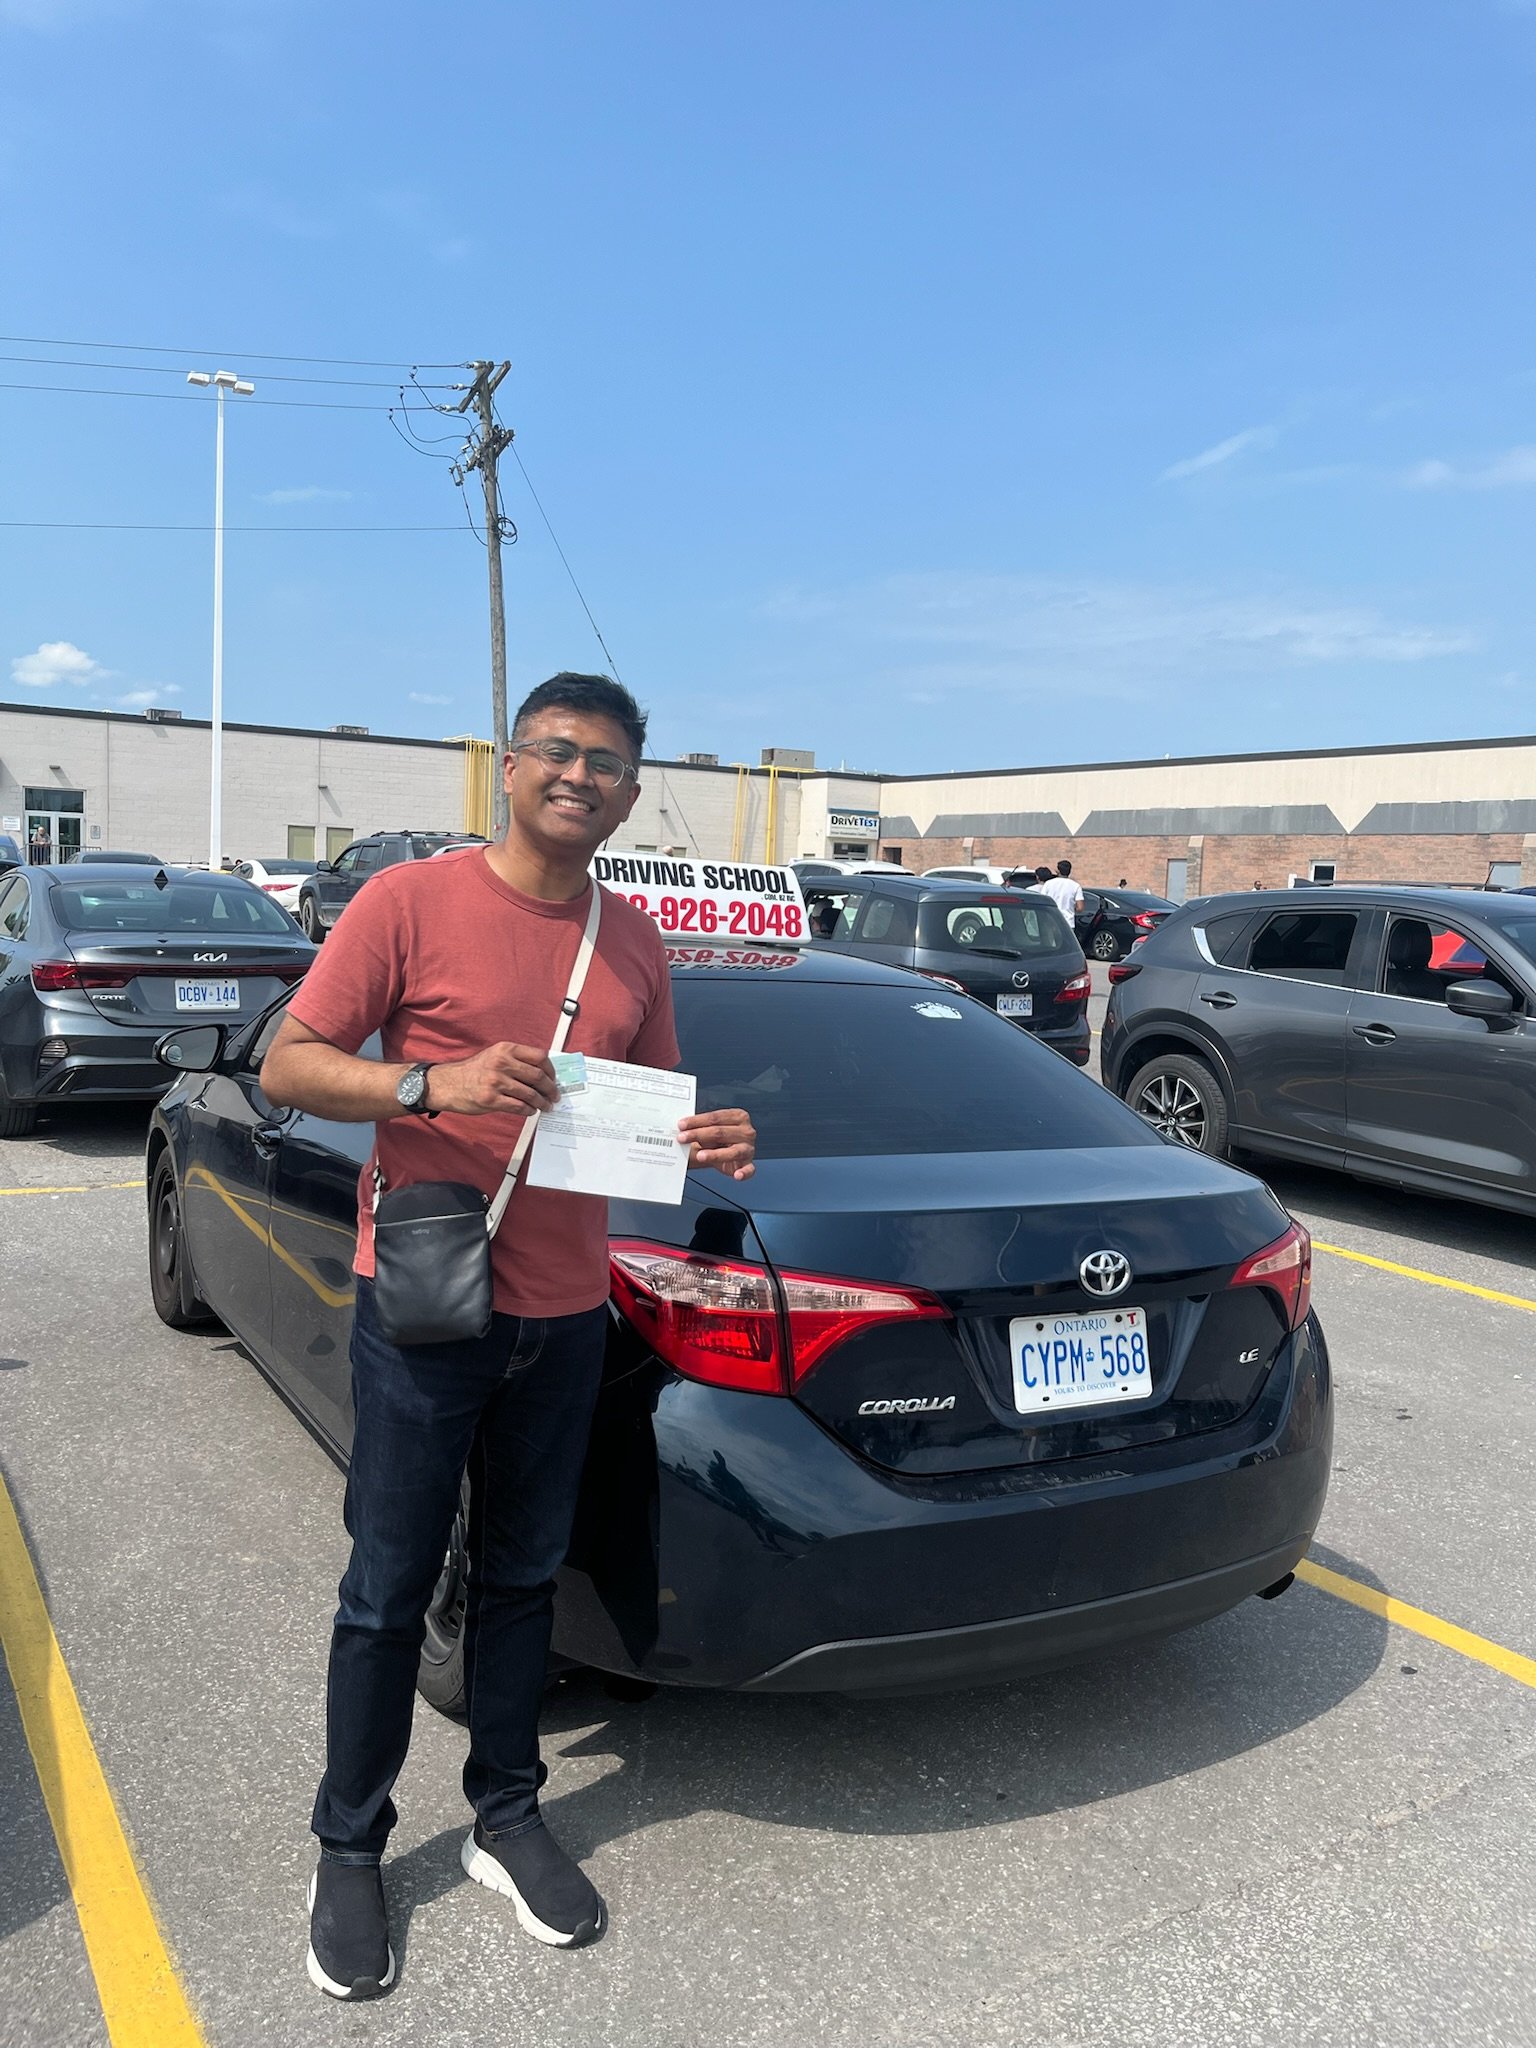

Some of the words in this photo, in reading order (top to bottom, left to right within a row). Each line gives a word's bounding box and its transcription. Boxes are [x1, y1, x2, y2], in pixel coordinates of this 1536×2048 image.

[594, 856, 696, 888] DRIVING
[702, 865, 795, 895] SCHOOL
[614, 892, 803, 938] -926-2048
[178, 986, 208, 1002] DCBV
[216, 986, 237, 1002] 144
[1054, 1318, 1107, 1335] ONTARIO
[1021, 1338, 1085, 1388] CYPM
[1100, 1332, 1146, 1378] 568
[1239, 1347, 1260, 1364] LE
[1054, 1387, 1075, 1395] YOURS
[1076, 1385, 1086, 1393] TO
[1086, 1381, 1117, 1391] DISCOVER
[858, 1395, 956, 1416] COROLLA
